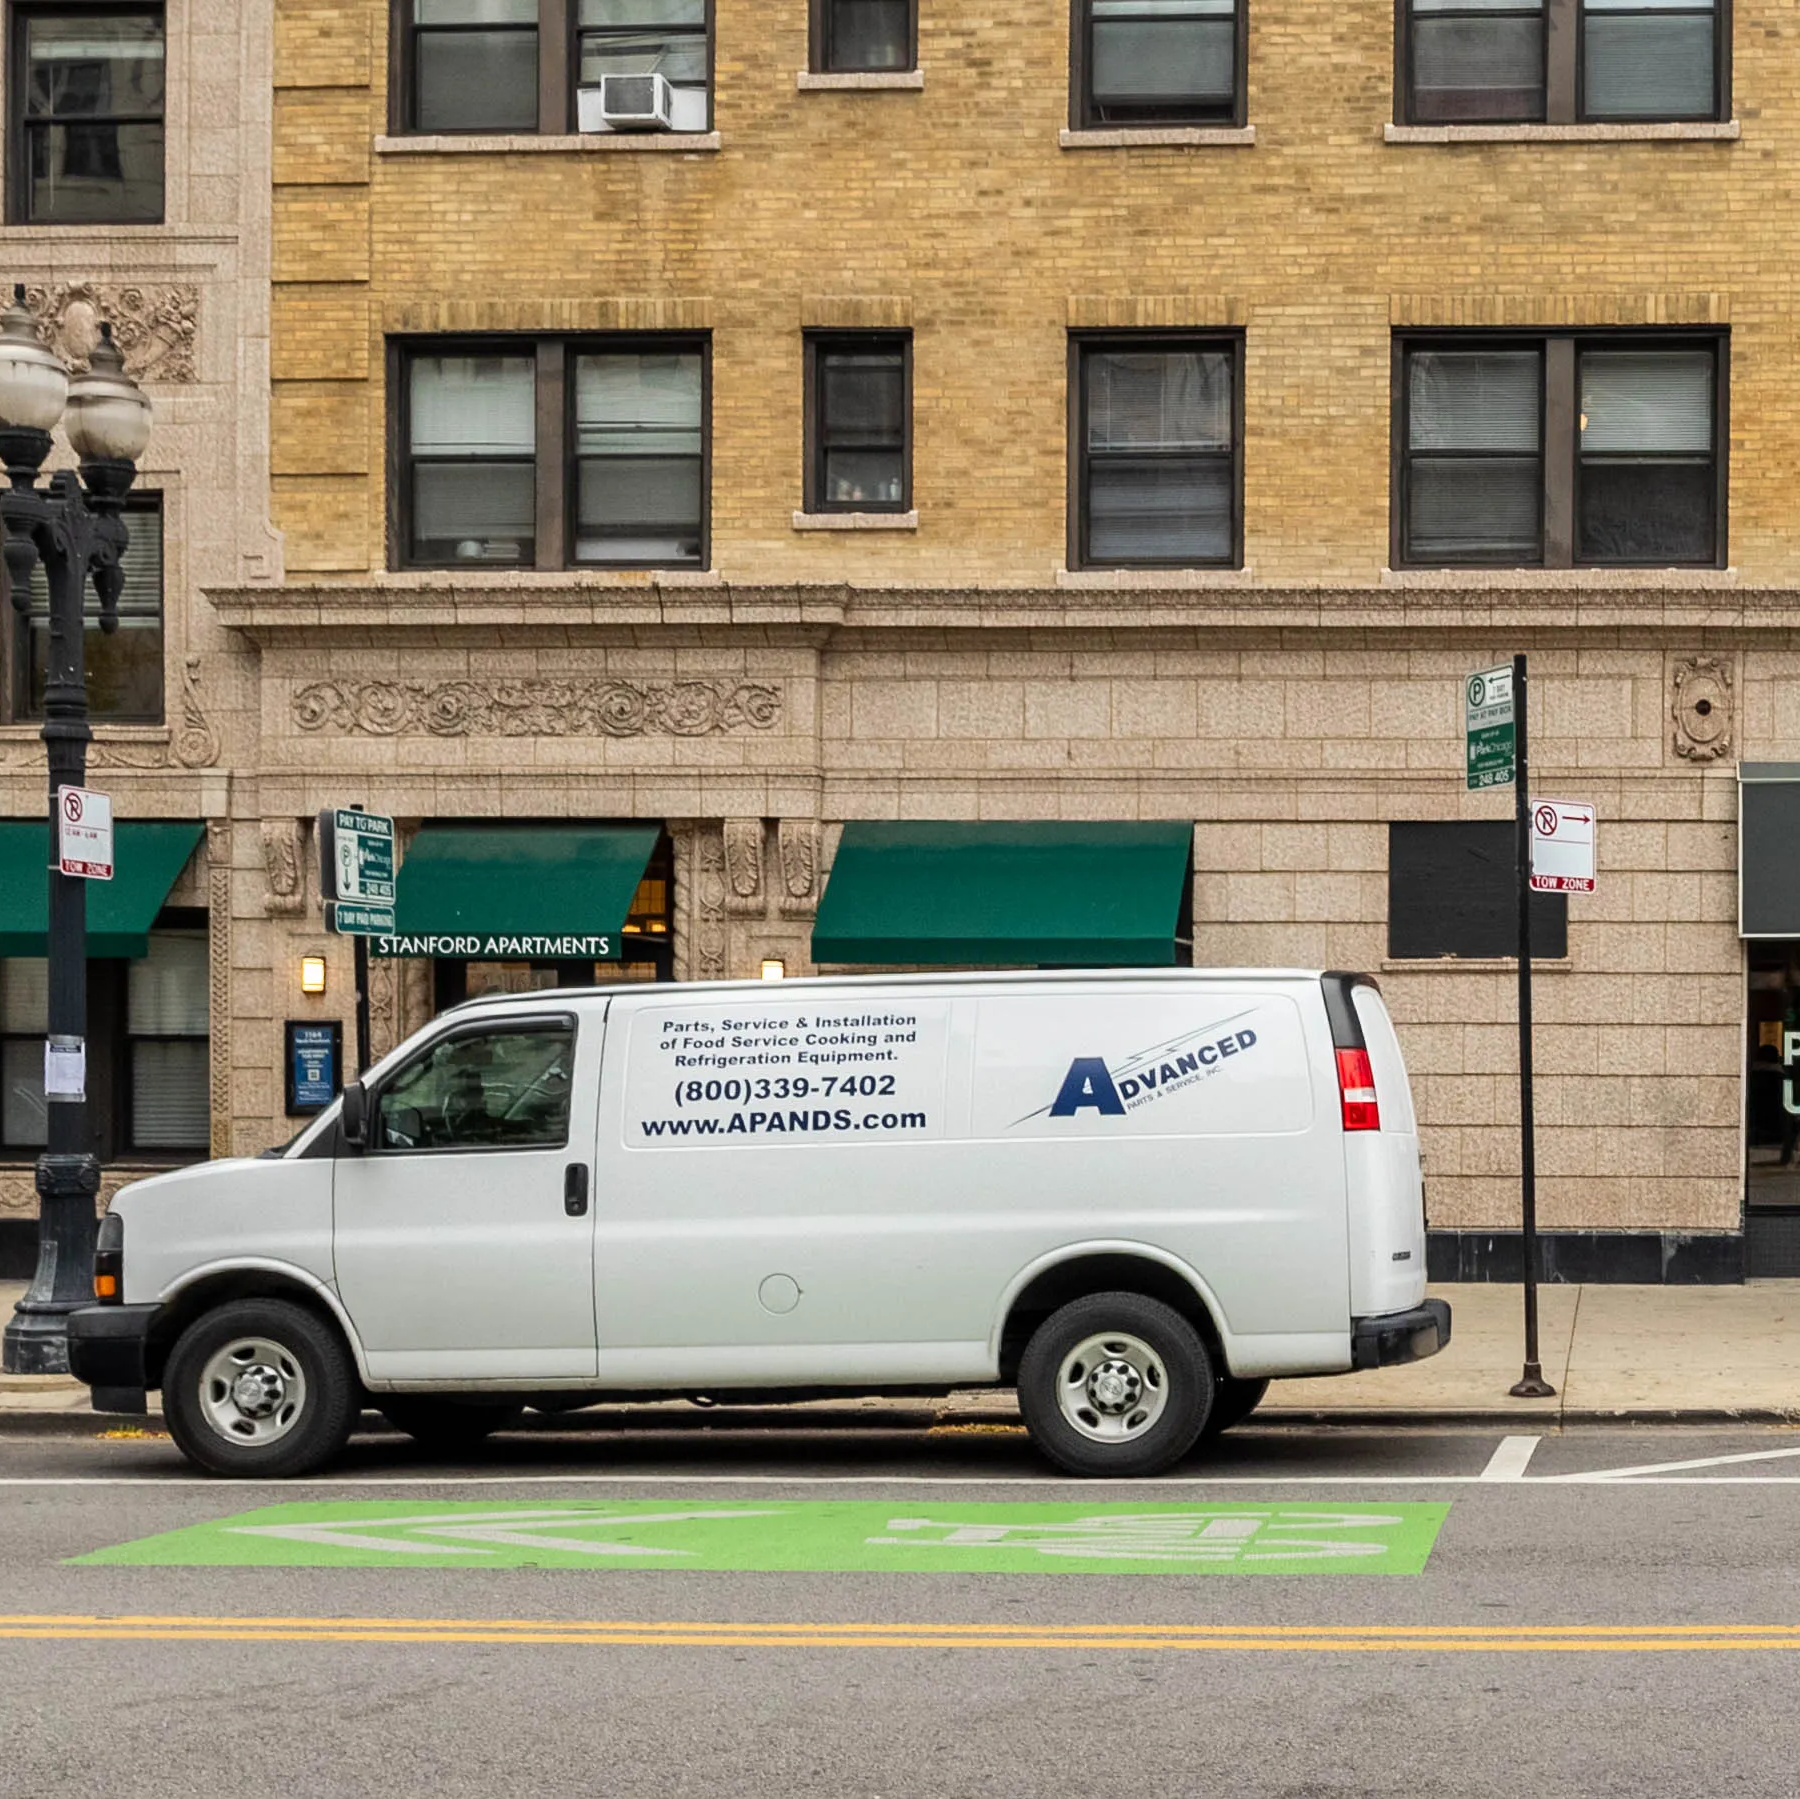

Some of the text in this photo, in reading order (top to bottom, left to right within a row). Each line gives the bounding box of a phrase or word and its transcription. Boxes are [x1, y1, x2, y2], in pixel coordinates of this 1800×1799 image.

[338, 813, 390, 834] PAY TO PARK
[1534, 874, 1590, 891] TOW ZONE
[379, 936, 609, 955] STANFORD APARTMENTS
[663, 1014, 917, 1033] Parts, Service & Installation
[660, 1031, 916, 1050] of Food Service Cooking and
[674, 1049, 898, 1069] Refrigeration Equipment.
[1048, 1029, 1257, 1117] ADVANCED
[674, 1074, 896, 1107] (800)339-7402
[1127, 1094, 1154, 1110] PARTS
[641, 1109, 927, 1136] www.APANDS.com
